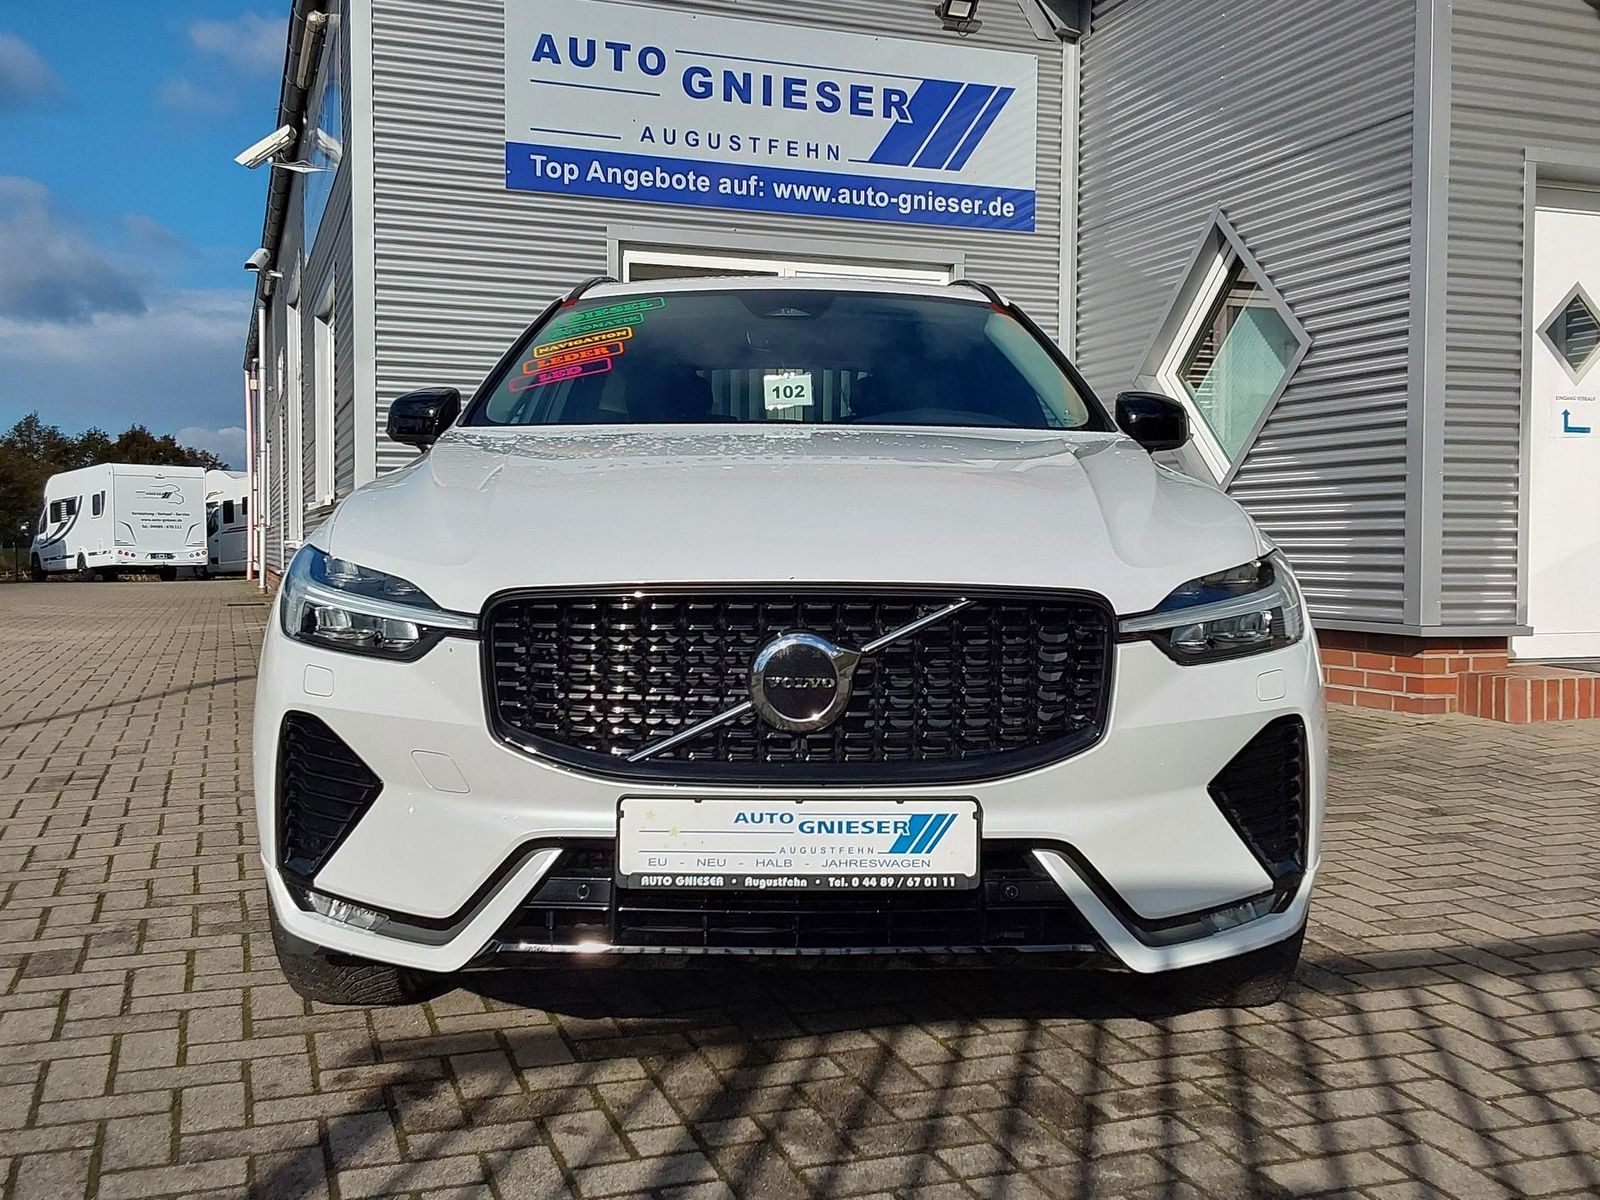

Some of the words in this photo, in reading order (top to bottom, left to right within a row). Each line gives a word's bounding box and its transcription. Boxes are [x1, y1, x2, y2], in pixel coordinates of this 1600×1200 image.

[531, 33, 667, 76] AUTO
[681, 66, 910, 121] GNIESER
[640, 126, 840, 161] AUGUSTFEHN
[529, 154, 579, 185] Top
[585, 160, 710, 192] Angebote
[718, 175, 765, 197] auf:
[773, 181, 1015, 217] www.auto-gnieser.de
[538, 330, 628, 355] NAVIGATION
[536, 346, 610, 369] LEDER
[538, 366, 583, 382] LED
[772, 385, 806, 399] 102
[765, 676, 836, 689] VOLVO
[733, 812, 794, 824] AUTO
[798, 820, 910, 835] GNIESER
[779, 846, 875, 855] AUGUSTFEHN
[648, 857, 668, 867] EU
[696, 858, 727, 867] NEU
[755, 859, 793, 868] HALB
[821, 859, 931, 868] JAHRESWAGEN
[640, 876, 673, 886] AUTO
[675, 876, 724, 887] GNIESER
[744, 877, 808, 889] Augustfehn
[828, 877, 849, 887] Tel.
